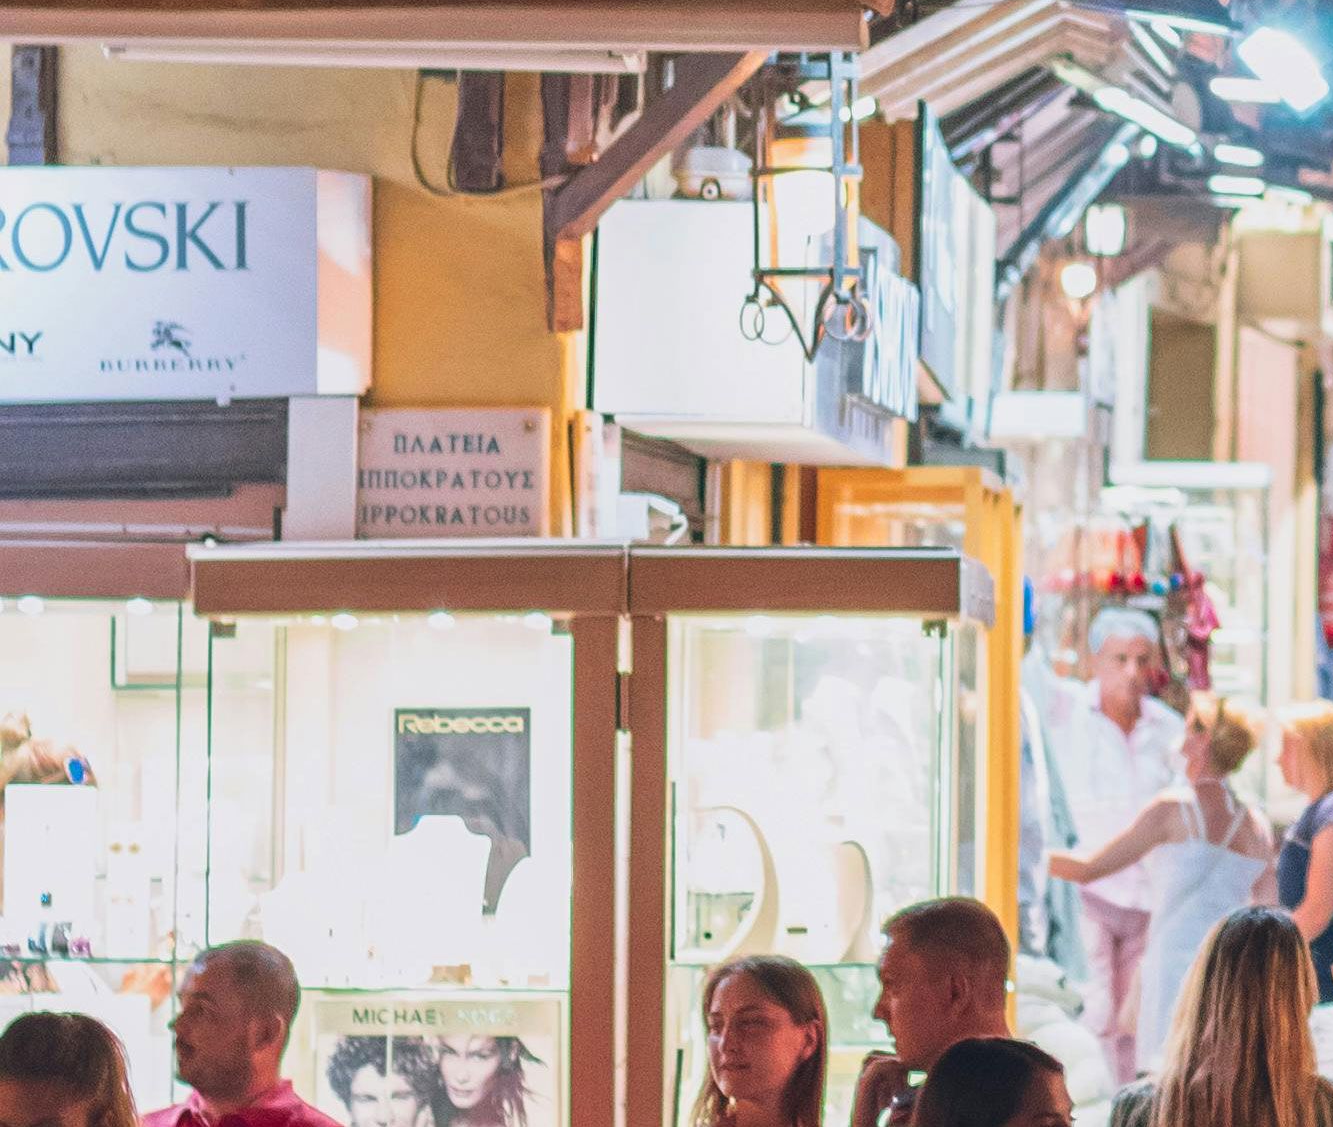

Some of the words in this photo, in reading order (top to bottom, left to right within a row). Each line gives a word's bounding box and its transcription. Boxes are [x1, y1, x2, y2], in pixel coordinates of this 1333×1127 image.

[99, 357, 237, 373] BURBERRY
[361, 504, 531, 524] IPPOKRATOUS
[398, 713, 525, 734] Rebecca
